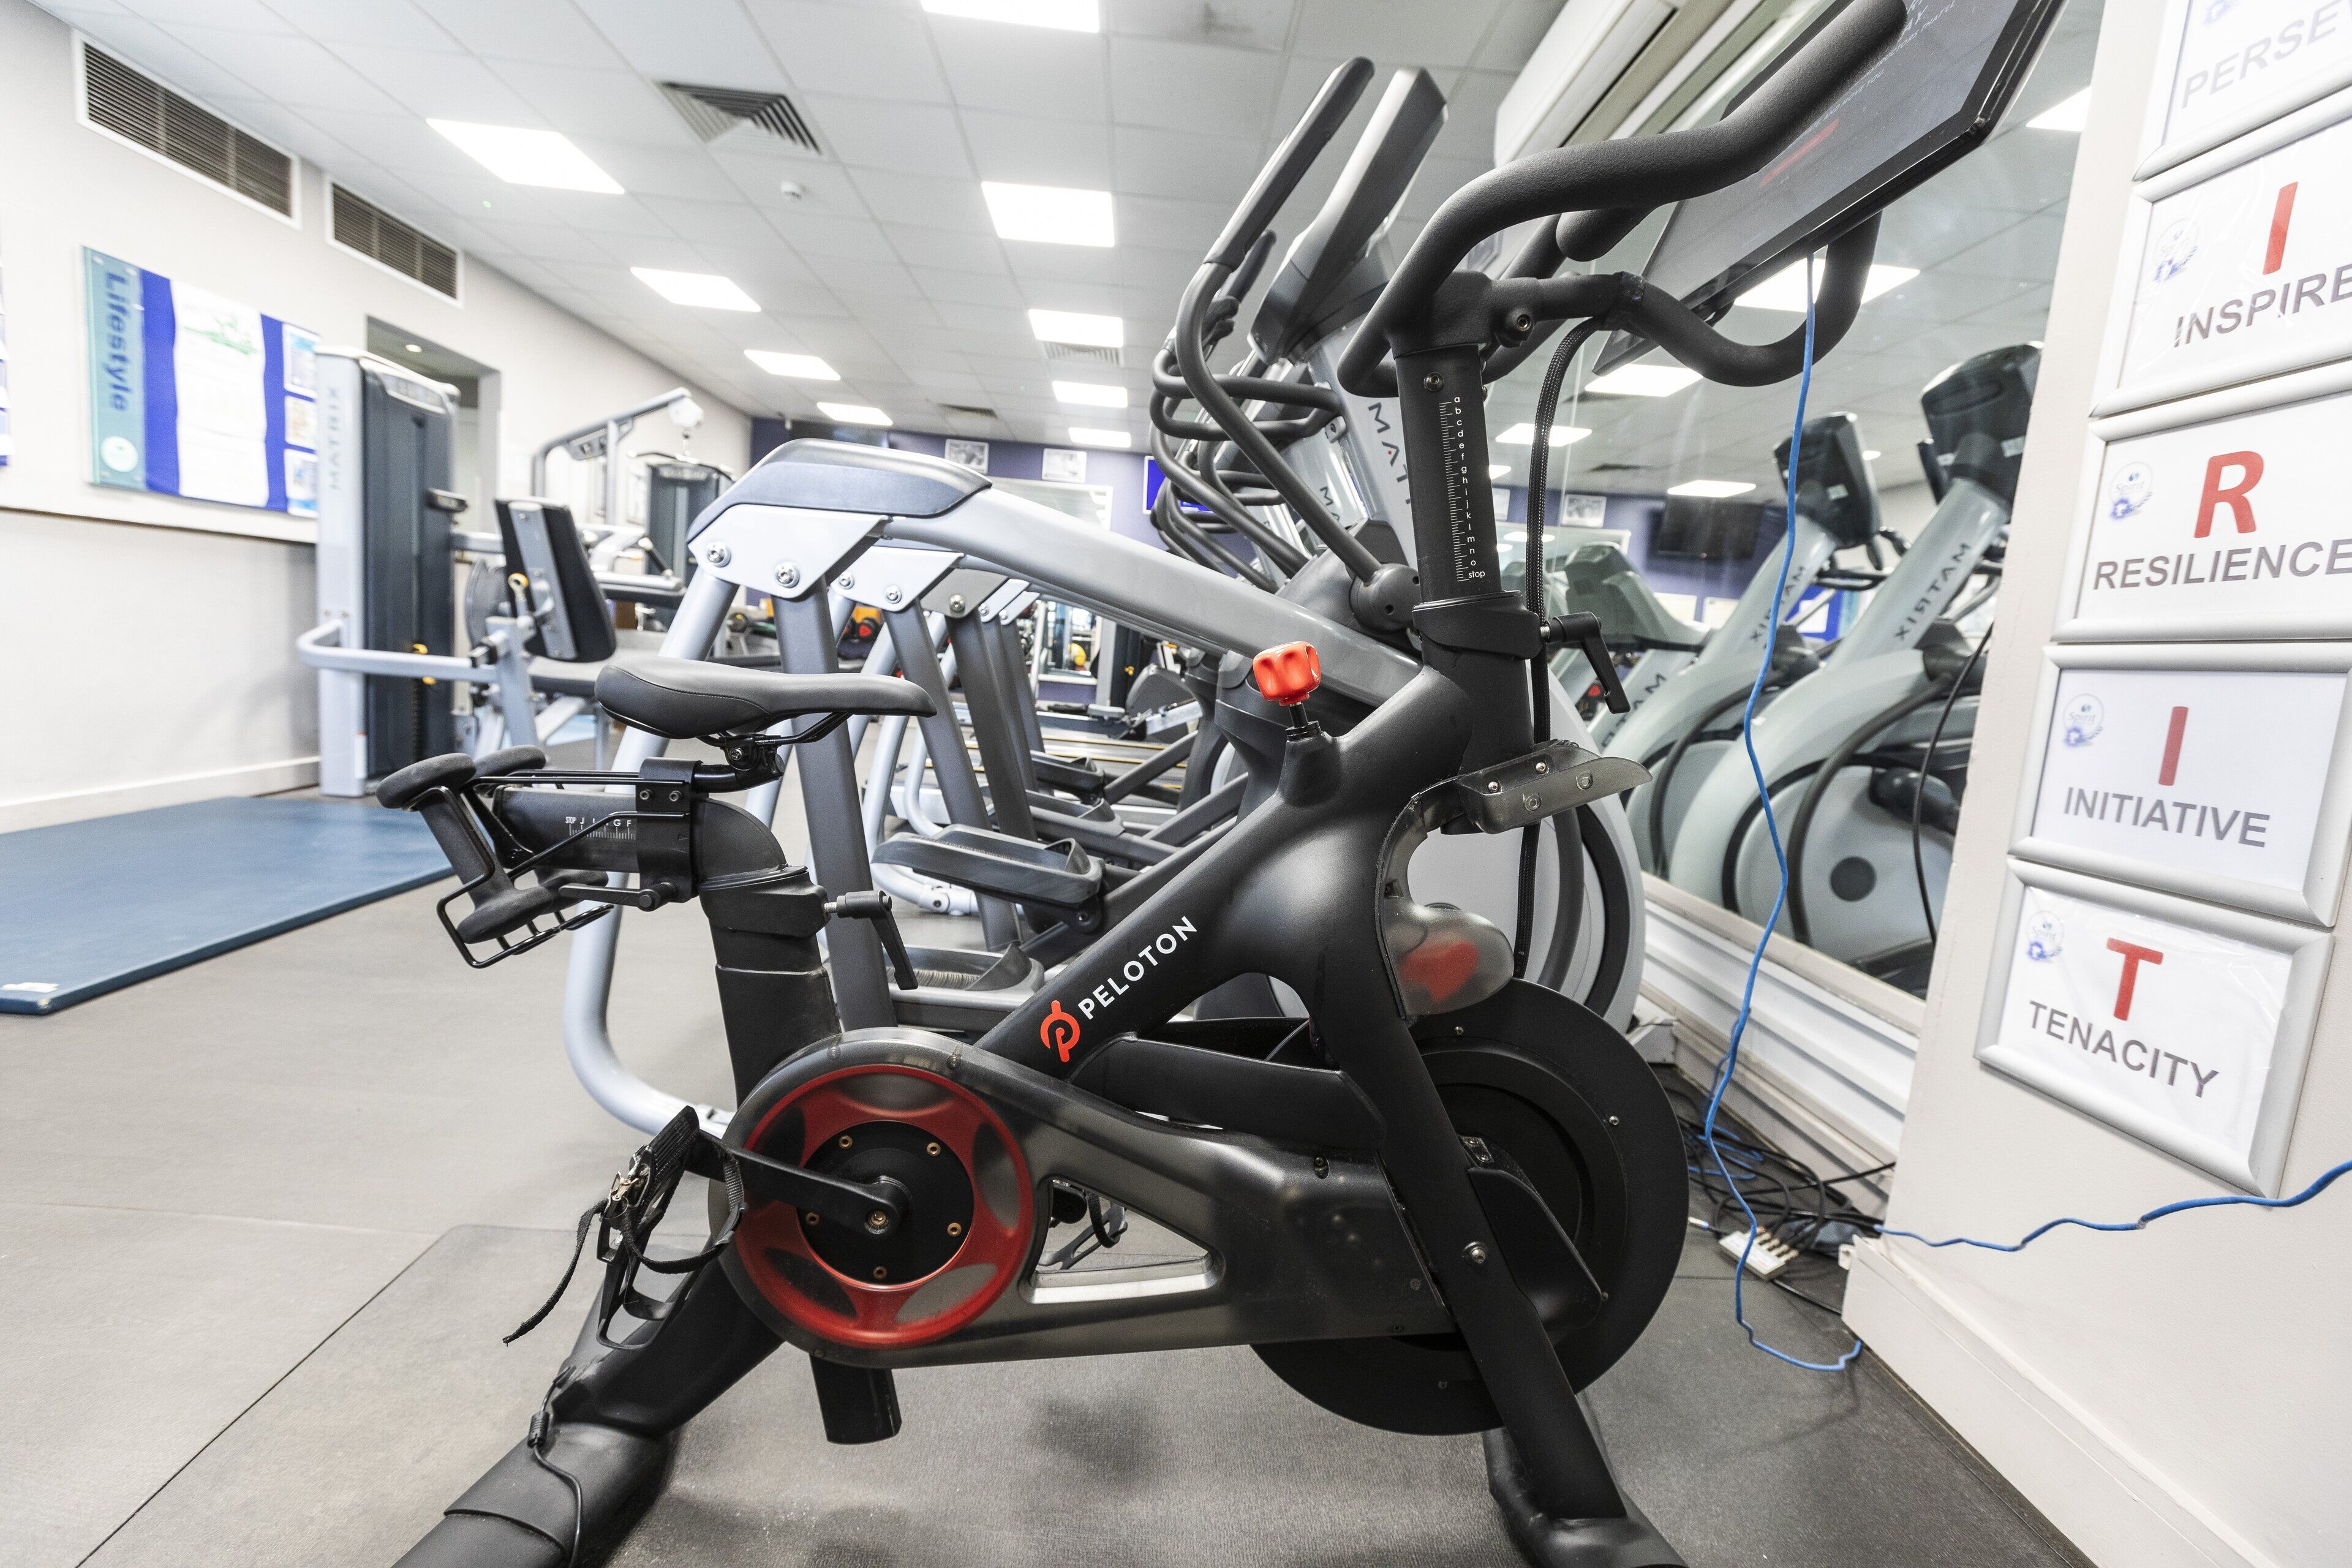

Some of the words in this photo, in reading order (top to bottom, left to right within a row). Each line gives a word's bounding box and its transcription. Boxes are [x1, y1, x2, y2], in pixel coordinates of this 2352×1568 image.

[1841, 83, 1866, 107] MOVE
[1864, 29, 1920, 76] NSTRUCTORS
[2181, 0, 2352, 110] PERSE
[2263, 182, 2299, 275] I
[2173, 263, 2352, 348] INSPIRE
[328, 386, 342, 491] MATRIX
[1368, 402, 1411, 505] MAT
[1466, 500, 1469, 509] j
[2193, 450, 2264, 538] R
[2093, 538, 2352, 590] RESILIENCE
[2158, 706, 2188, 786] I
[2063, 786, 2271, 848] INITIATIVE
[1077, 916, 1197, 1020] PELOTON
[2106, 937, 2163, 1022] T
[2029, 1000, 2220, 1098] TENACITY
